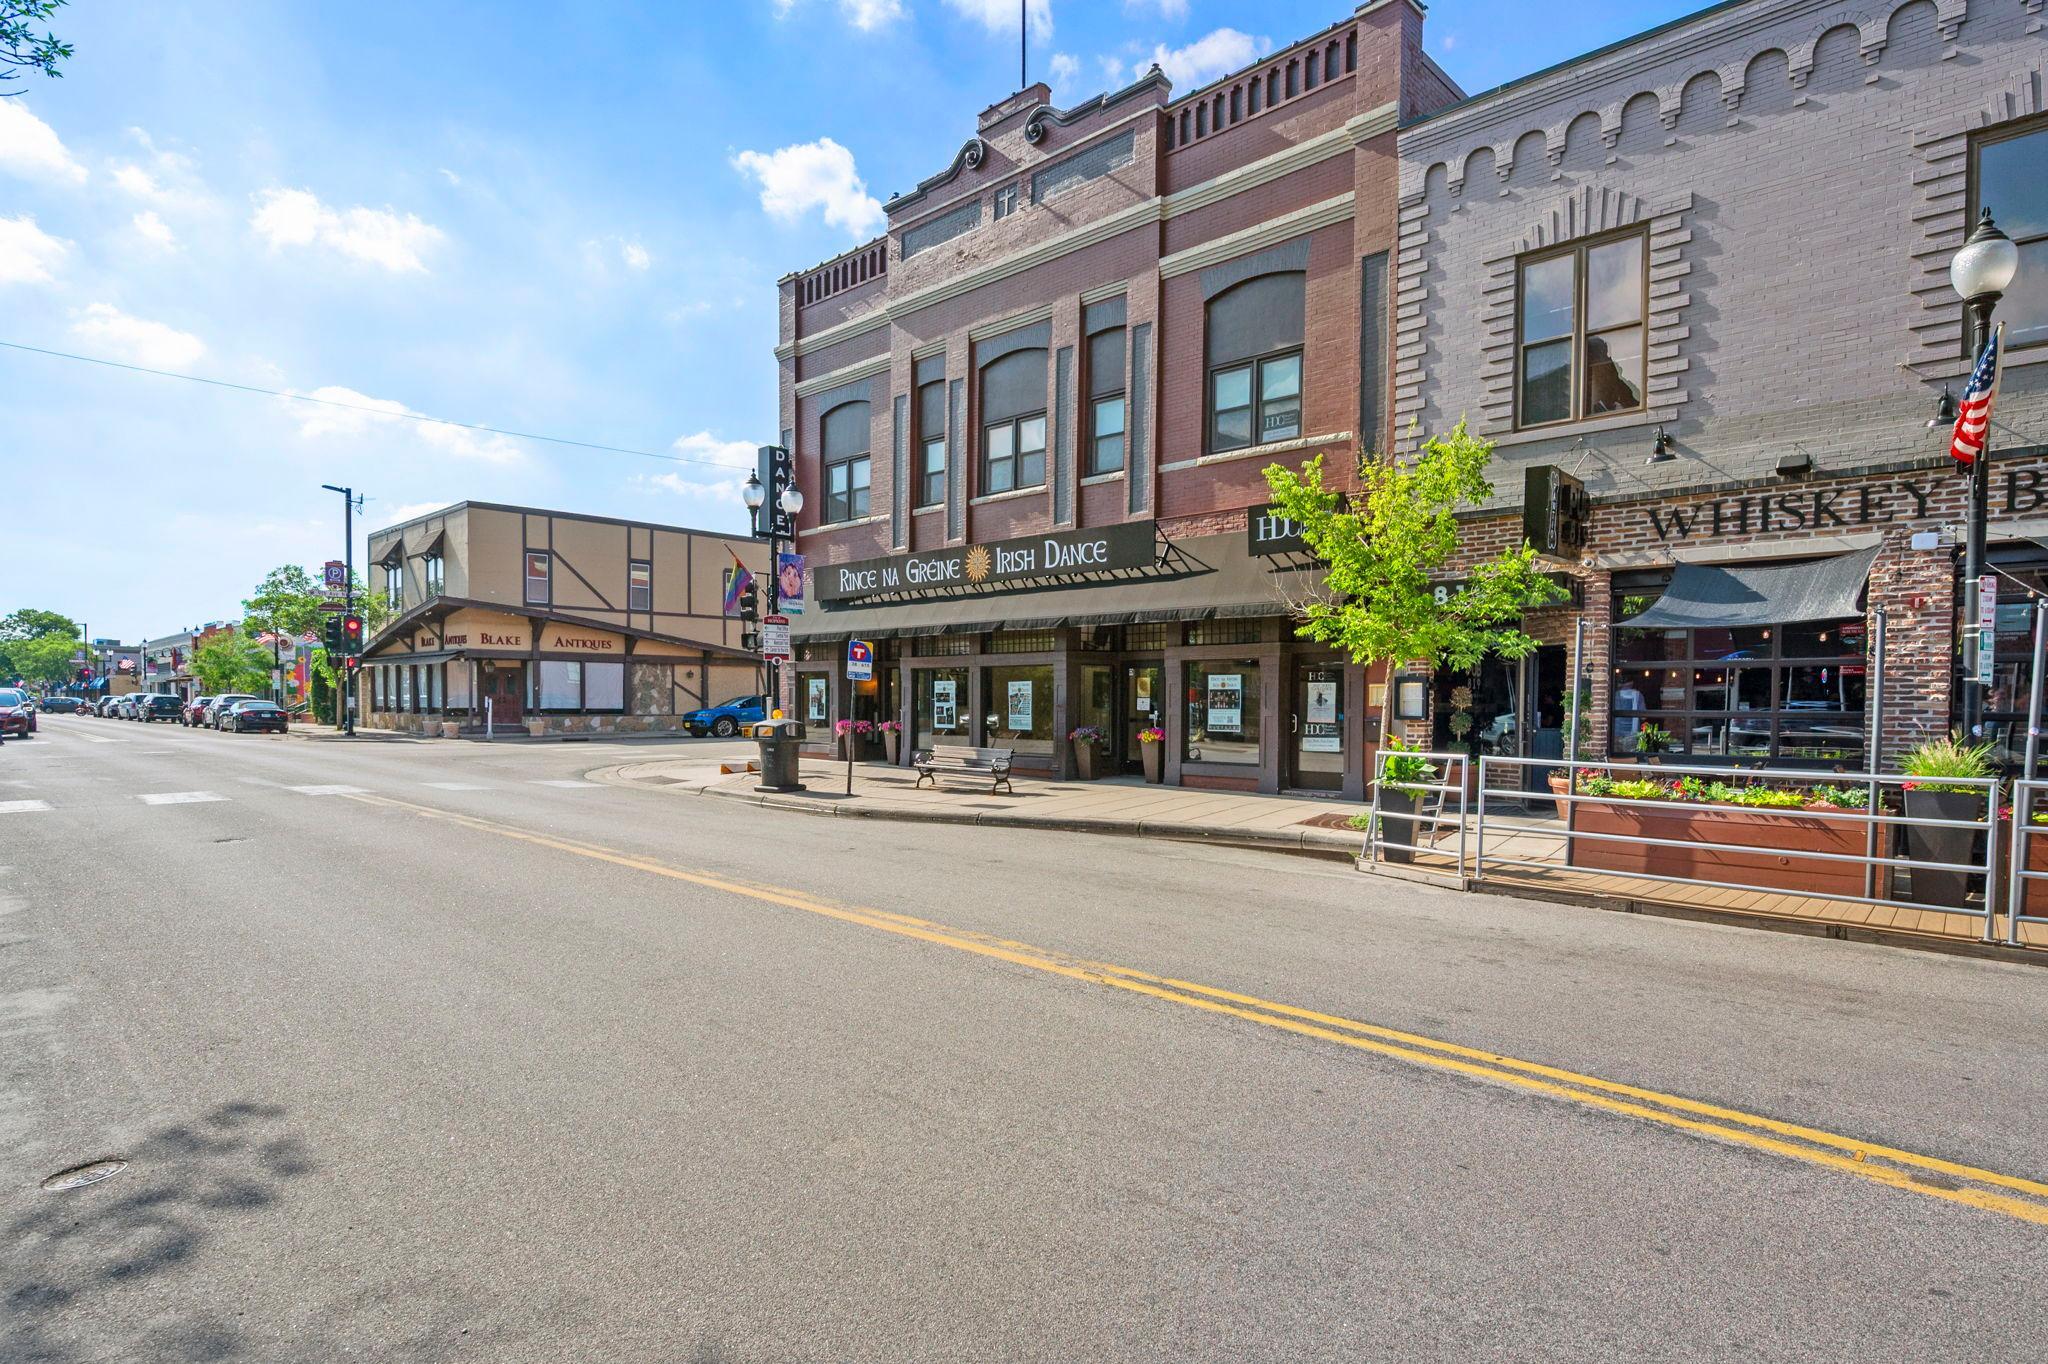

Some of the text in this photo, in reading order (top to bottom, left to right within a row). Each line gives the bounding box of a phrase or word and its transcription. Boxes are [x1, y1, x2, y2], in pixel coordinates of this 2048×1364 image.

[775, 450, 786, 526] DANCE
[1646, 478, 1944, 542] WHISKEY
[839, 540, 1107, 593] RINCE NA GRÉINE IRISH DANCE
[421, 633, 612, 650] BLAKE ANTIQUES BLAKE ANTIQUES
